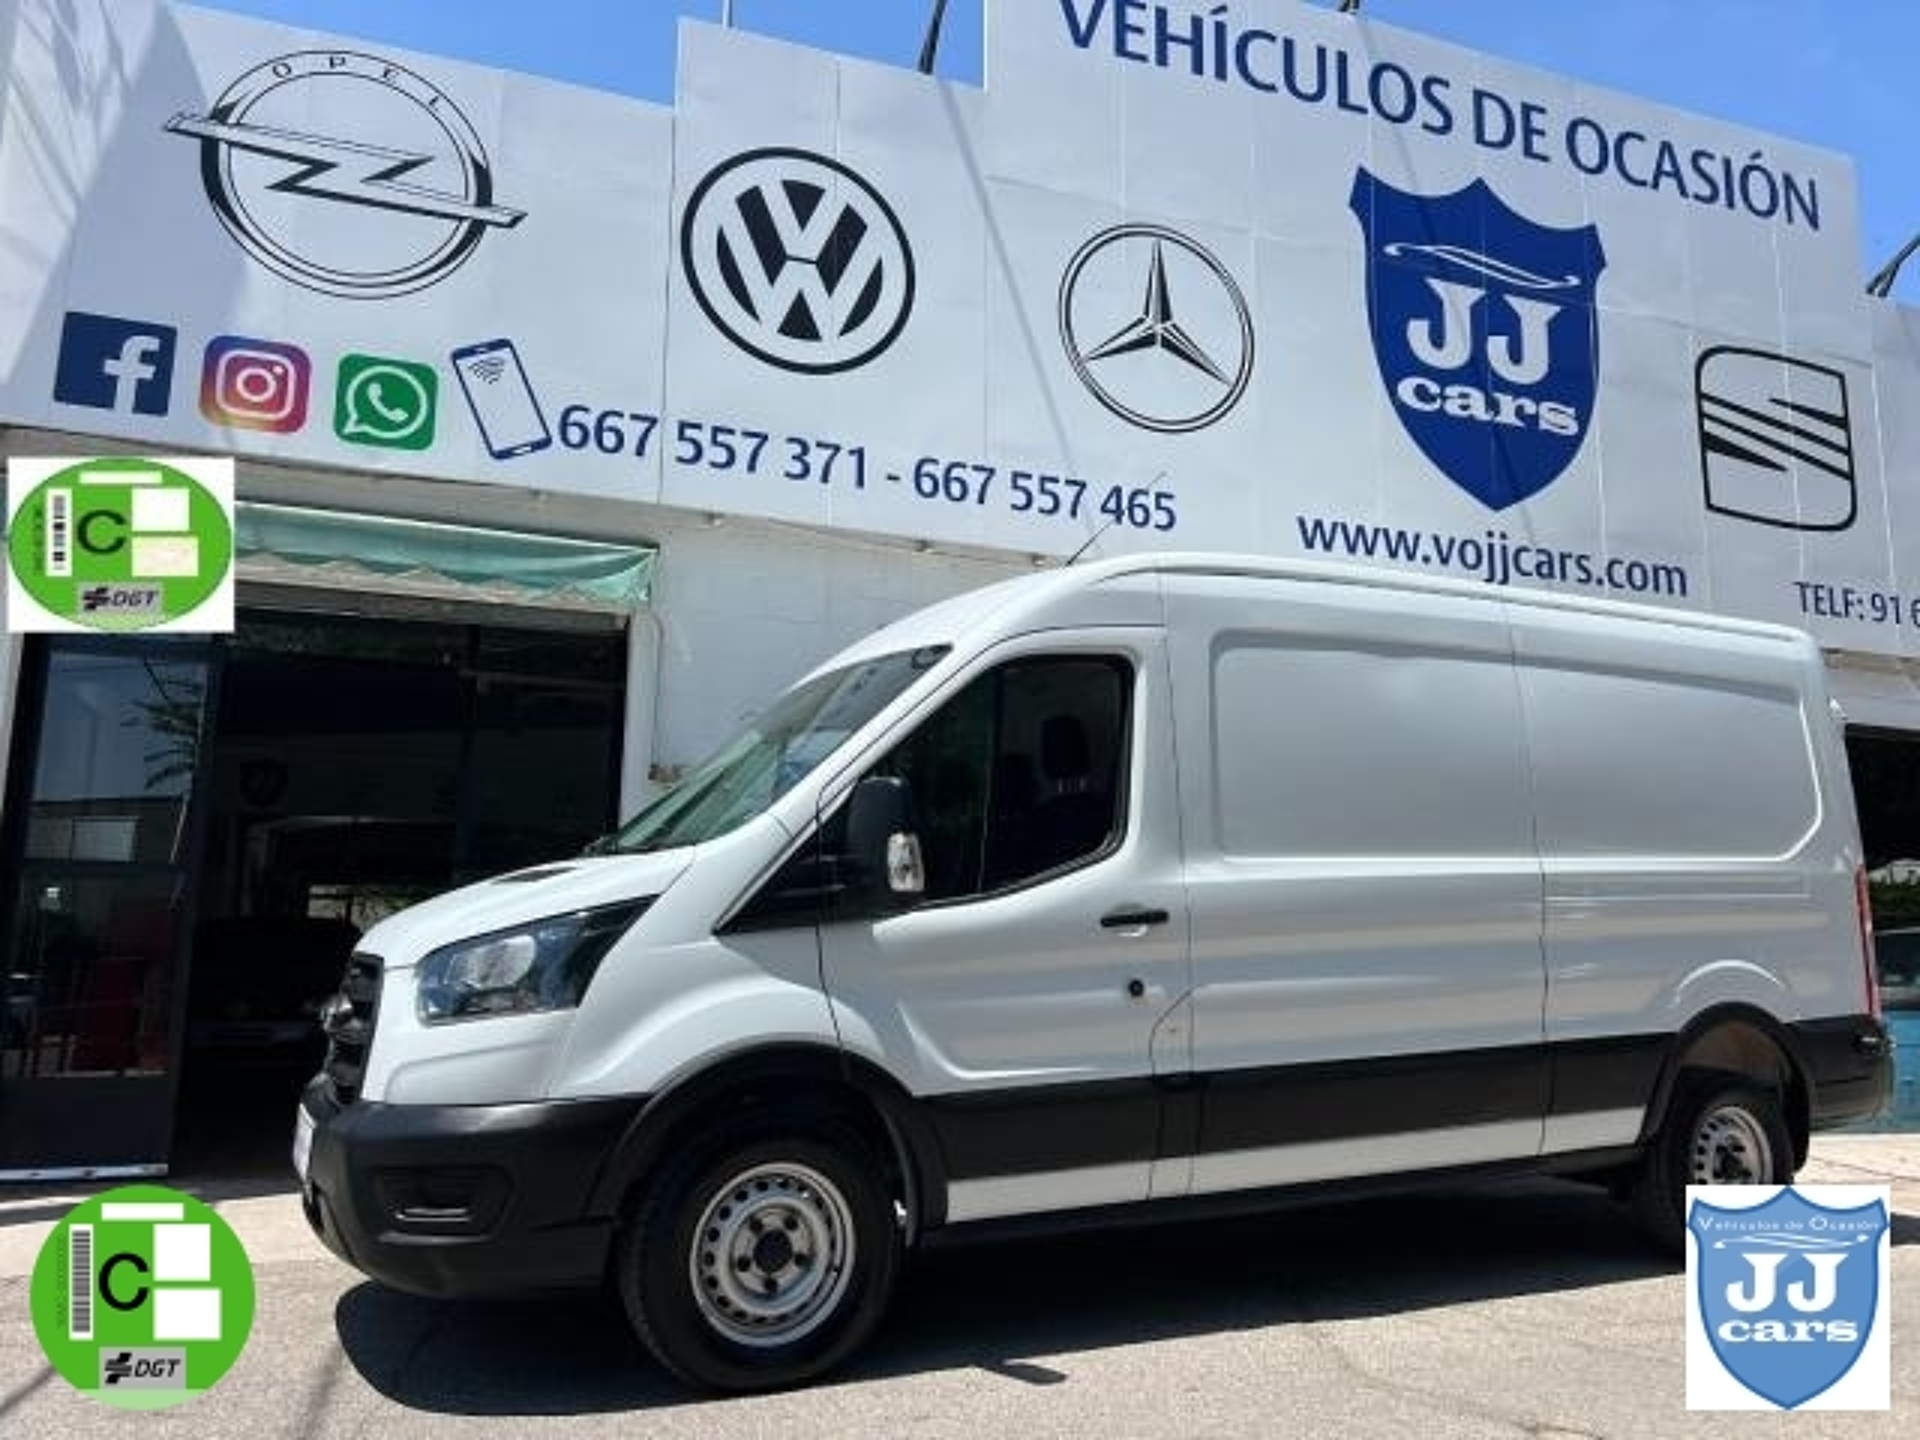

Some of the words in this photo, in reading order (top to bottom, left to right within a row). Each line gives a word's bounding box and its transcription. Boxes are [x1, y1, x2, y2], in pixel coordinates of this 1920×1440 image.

[271, 55, 446, 112] OPEL
[1060, 0, 1453, 136] VEHÍCULOS
[1473, 88, 1550, 163] DE
[1565, 117, 1820, 231] OCASIÓN
[1405, 277, 1562, 384] JJ
[1397, 376, 1580, 436] cars
[558, 404, 658, 457] 667
[675, 420, 769, 473] 557
[783, 436, 866, 489] 371
[913, 457, 996, 505] 667
[1010, 471, 1087, 519] 557
[1100, 485, 1177, 531] 465
[1297, 515, 1688, 597] www.vojjcars.com
[1791, 581, 1864, 621] TELF:
